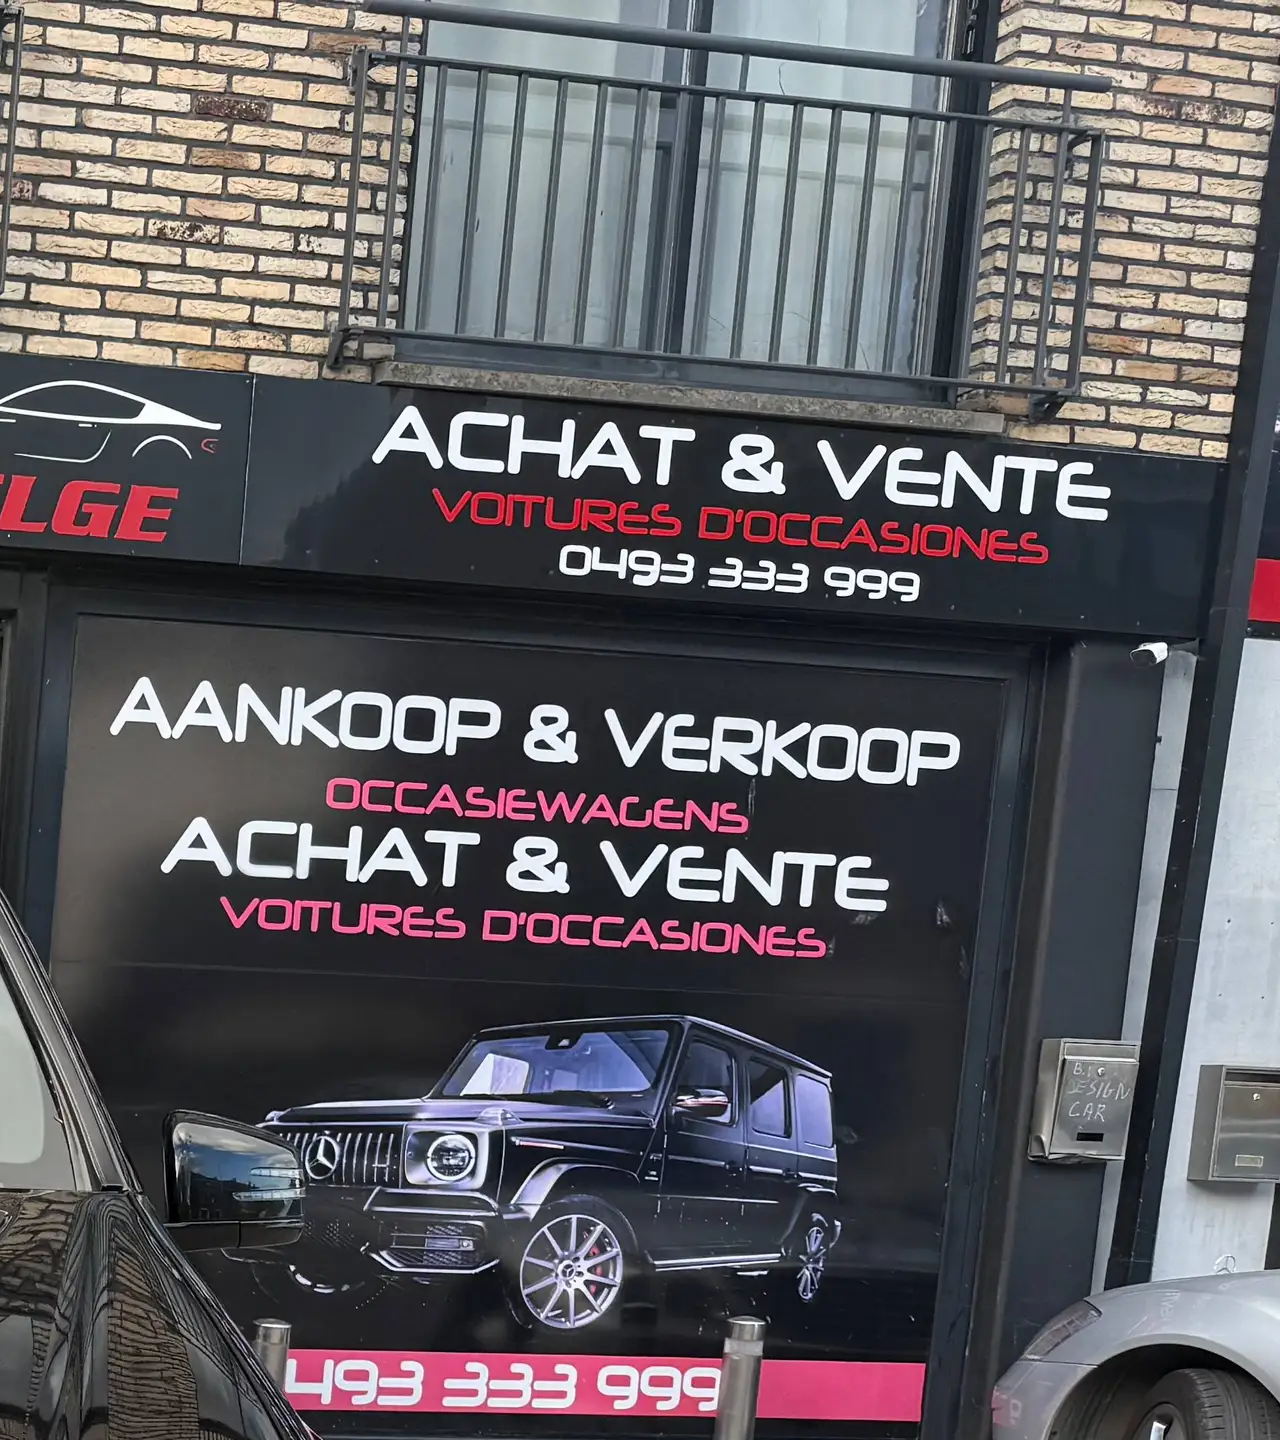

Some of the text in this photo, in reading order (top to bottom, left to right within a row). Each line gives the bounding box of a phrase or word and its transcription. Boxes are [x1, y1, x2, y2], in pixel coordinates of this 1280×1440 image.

[371, 405, 1114, 522] ACHAT & VENTE
[433, 488, 1049, 565] VOITURES D'OCCASIONES
[558, 544, 921, 602] 0493 333 999
[109, 676, 961, 787] AANKOOP & VERKOOP
[325, 777, 749, 834] OCCASIEWAGENS
[160, 816, 890, 912] ACHAT & VENTE
[220, 896, 827, 959] VOITURES D'OCCASIONES
[1067, 1079, 1131, 1100] DESIGN
[1068, 1100, 1105, 1122] CAR
[441, 1361, 578, 1409] 333
[596, 1364, 720, 1412] 999
